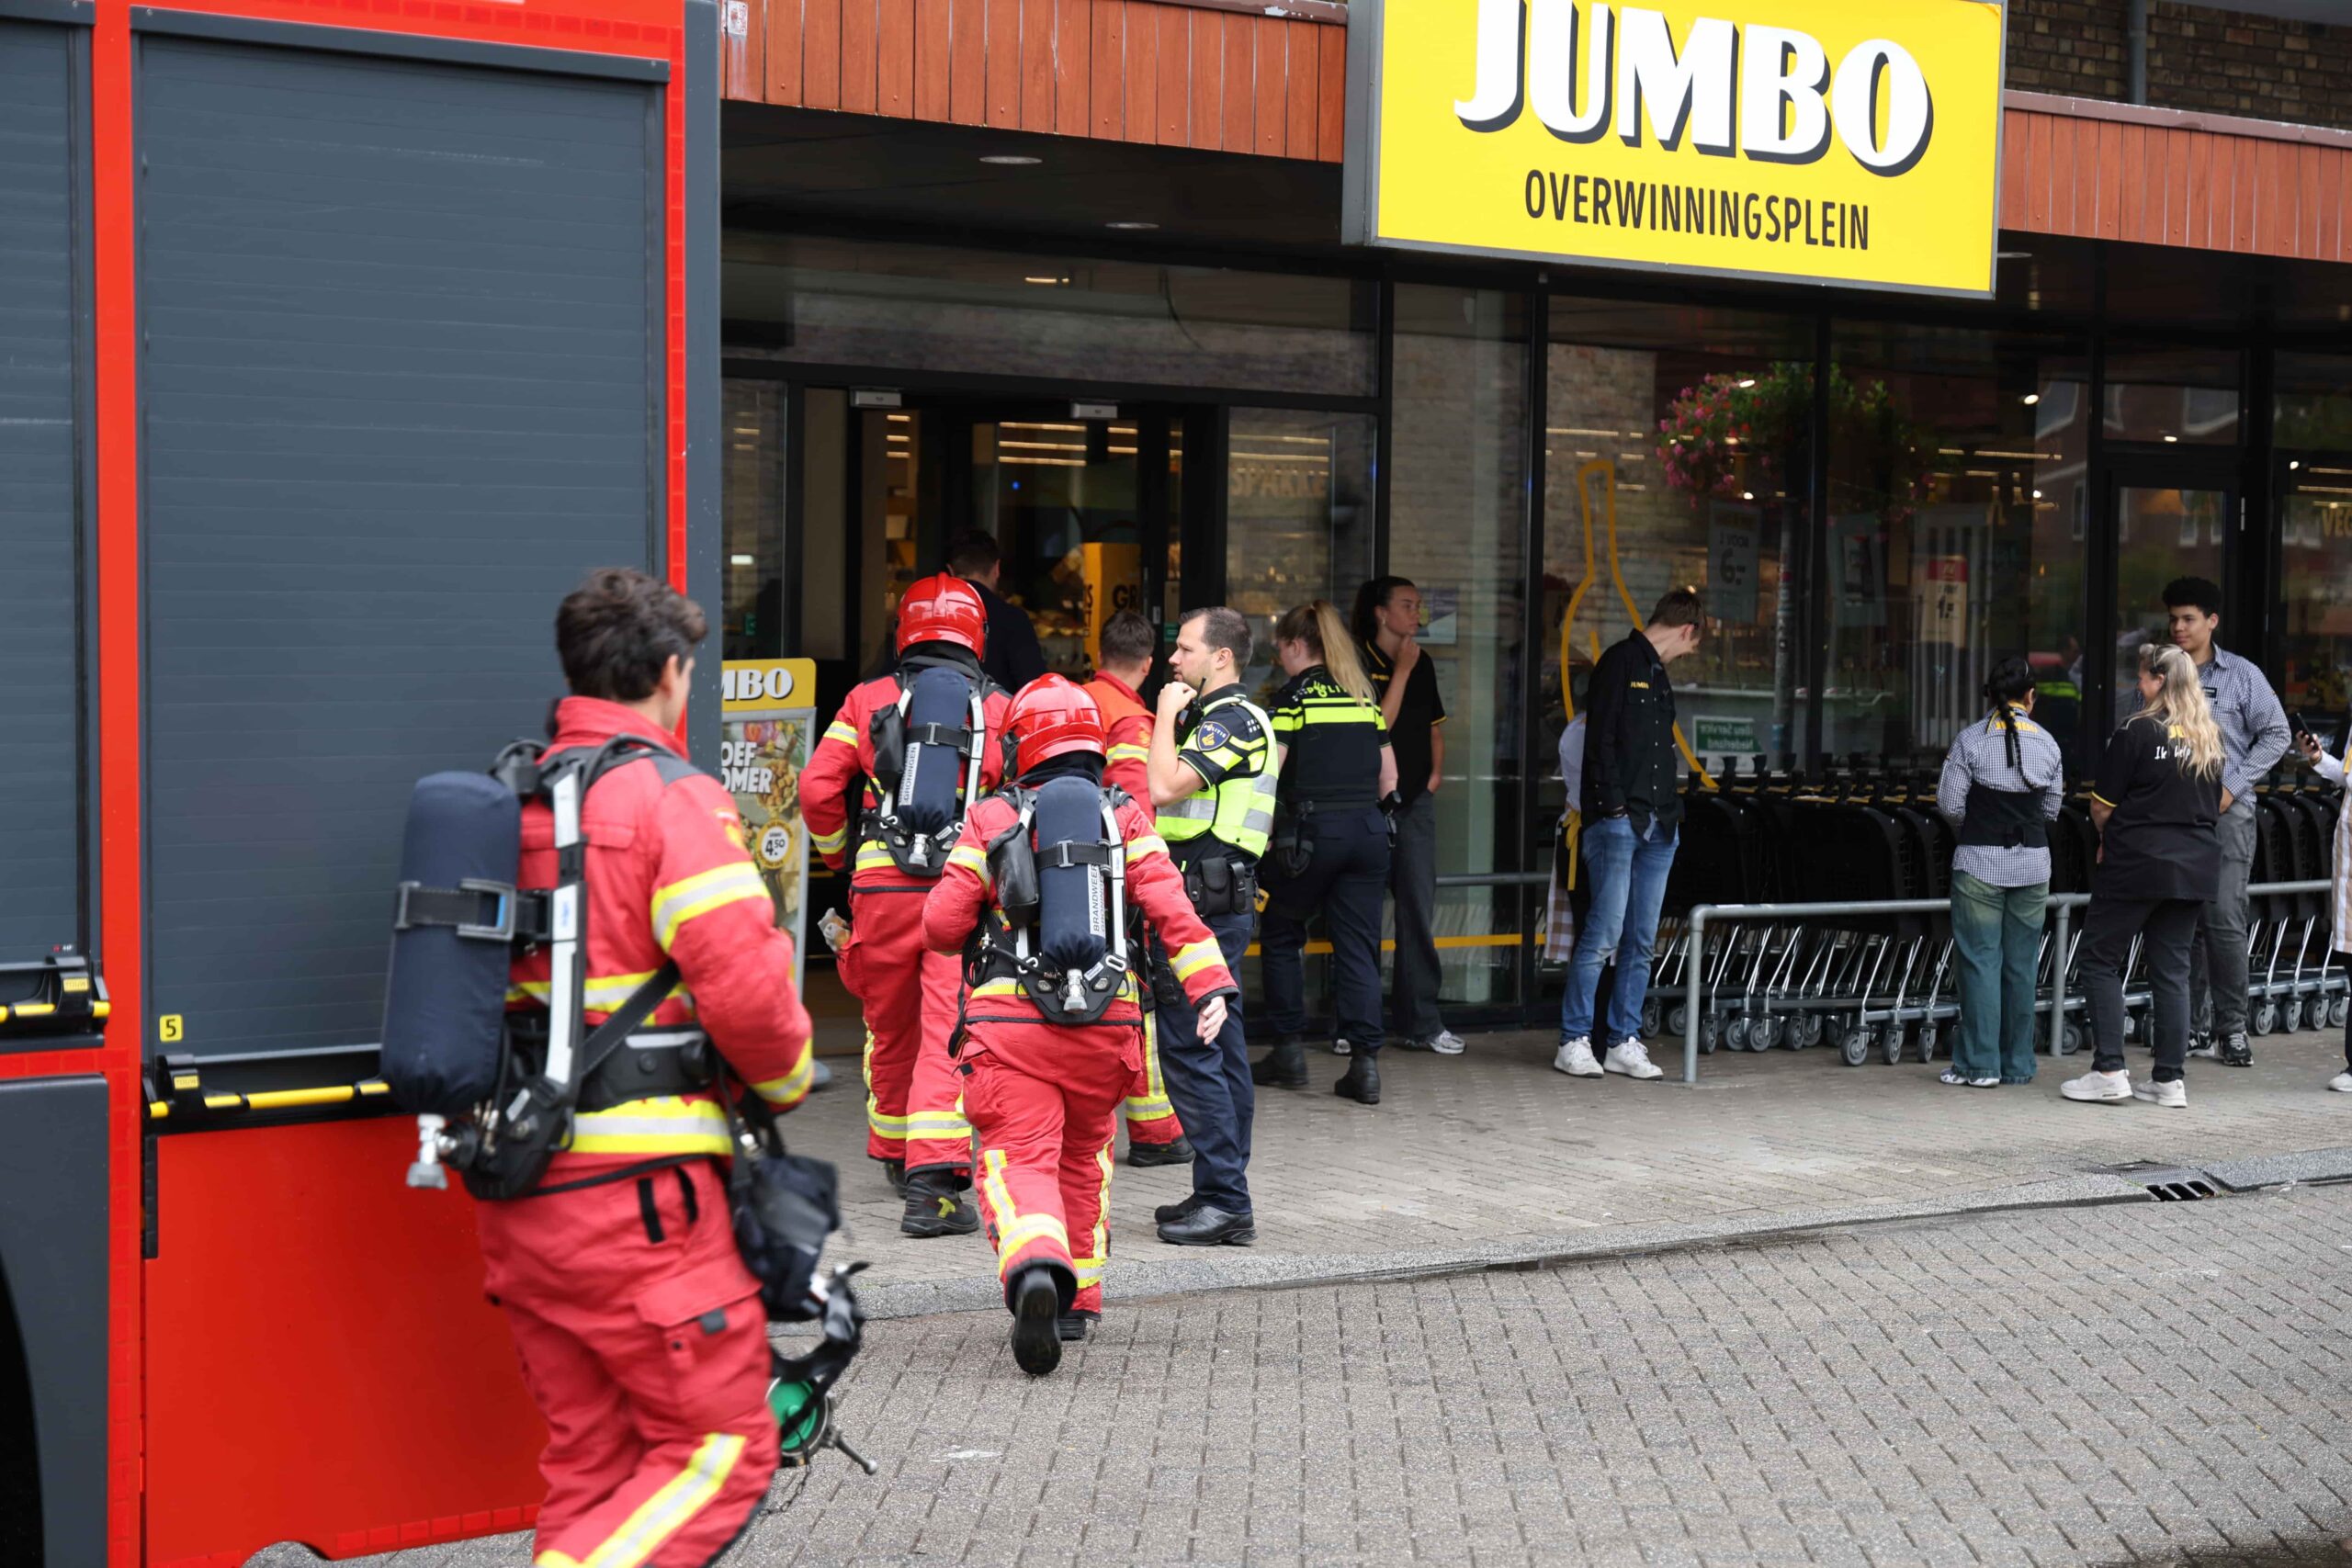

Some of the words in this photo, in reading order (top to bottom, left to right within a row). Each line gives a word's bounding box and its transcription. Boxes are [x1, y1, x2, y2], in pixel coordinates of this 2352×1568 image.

[1453, 0, 1934, 177] JUMBO
[1524, 169, 1870, 251] OVERWINNINGSPLEIN
[165, 1018, 176, 1038] 5
